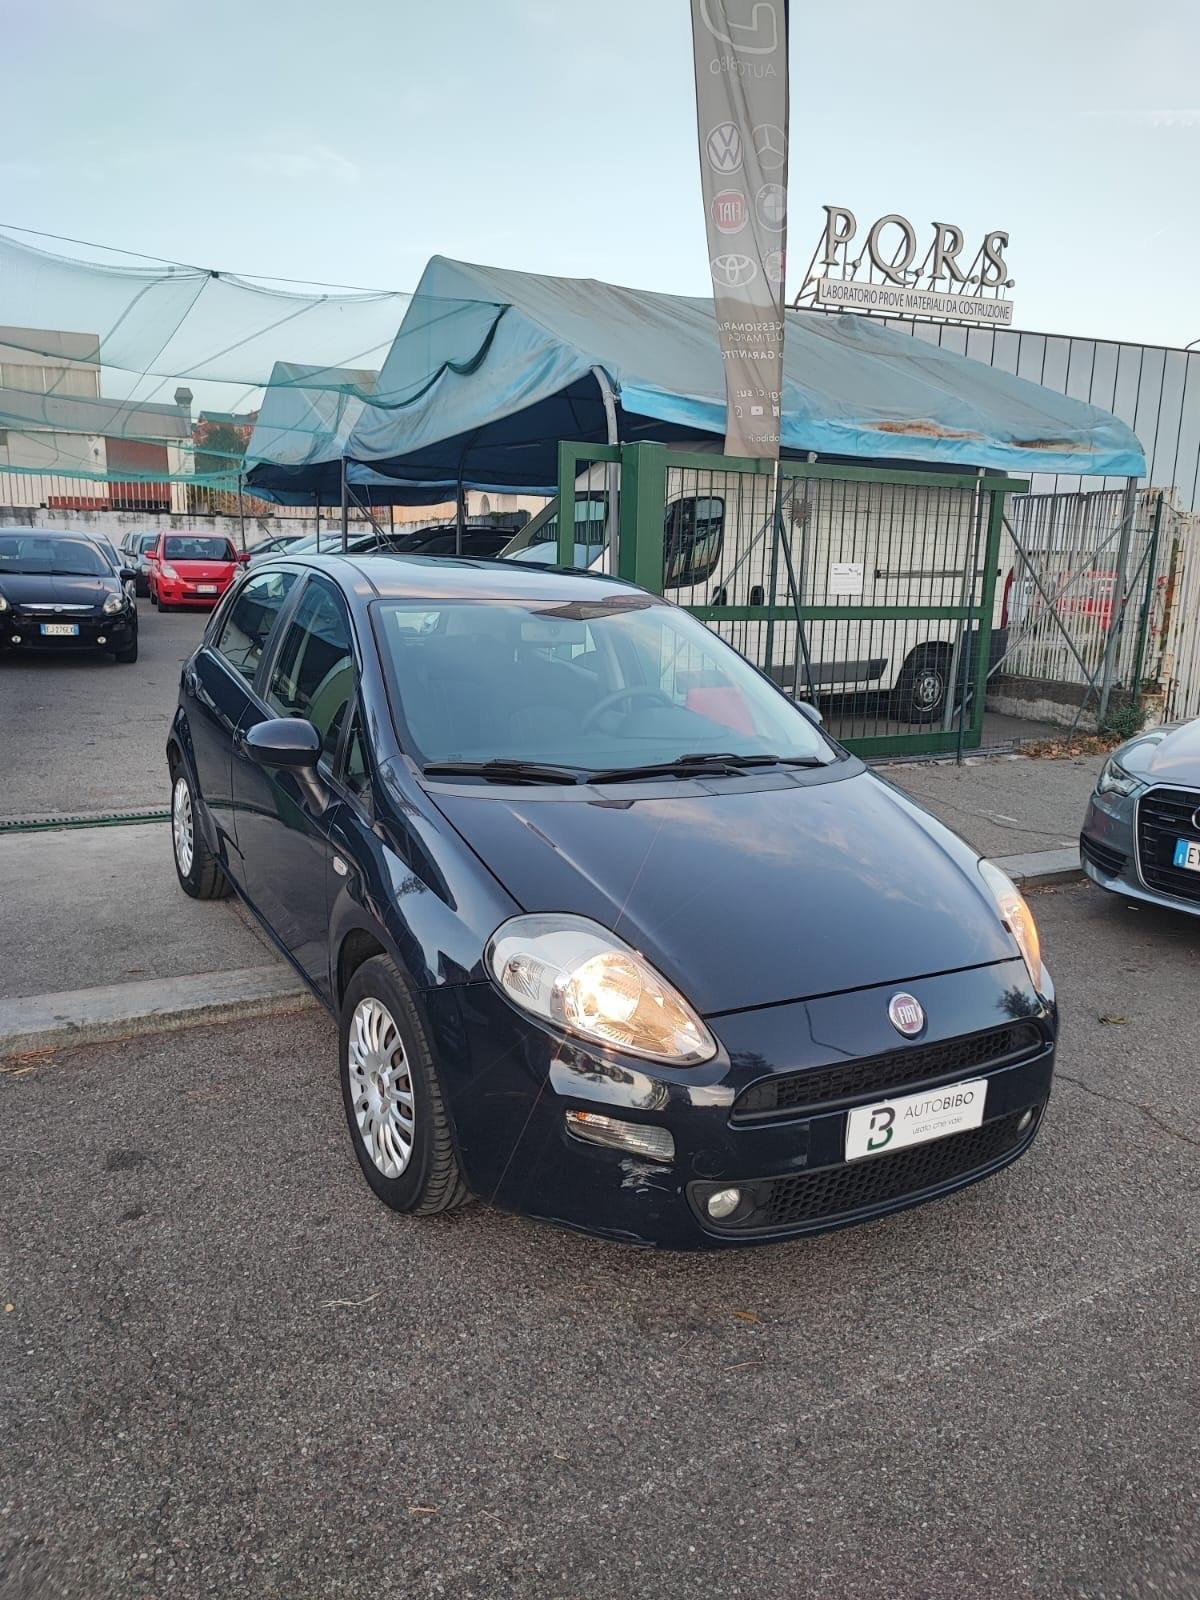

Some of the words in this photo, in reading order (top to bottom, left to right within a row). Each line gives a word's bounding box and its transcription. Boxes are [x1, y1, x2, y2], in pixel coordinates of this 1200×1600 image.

[821, 284, 877, 304] LABORATORIO
[878, 292, 904, 308] PROVE
[905, 296, 945, 313] MATERIALI
[946, 301, 957, 313] DA
[958, 302, 1010, 320] COSTRUZIONE
[897, 1004, 918, 1025] FIAT
[903, 1091, 974, 1120] AUTOBIBO
